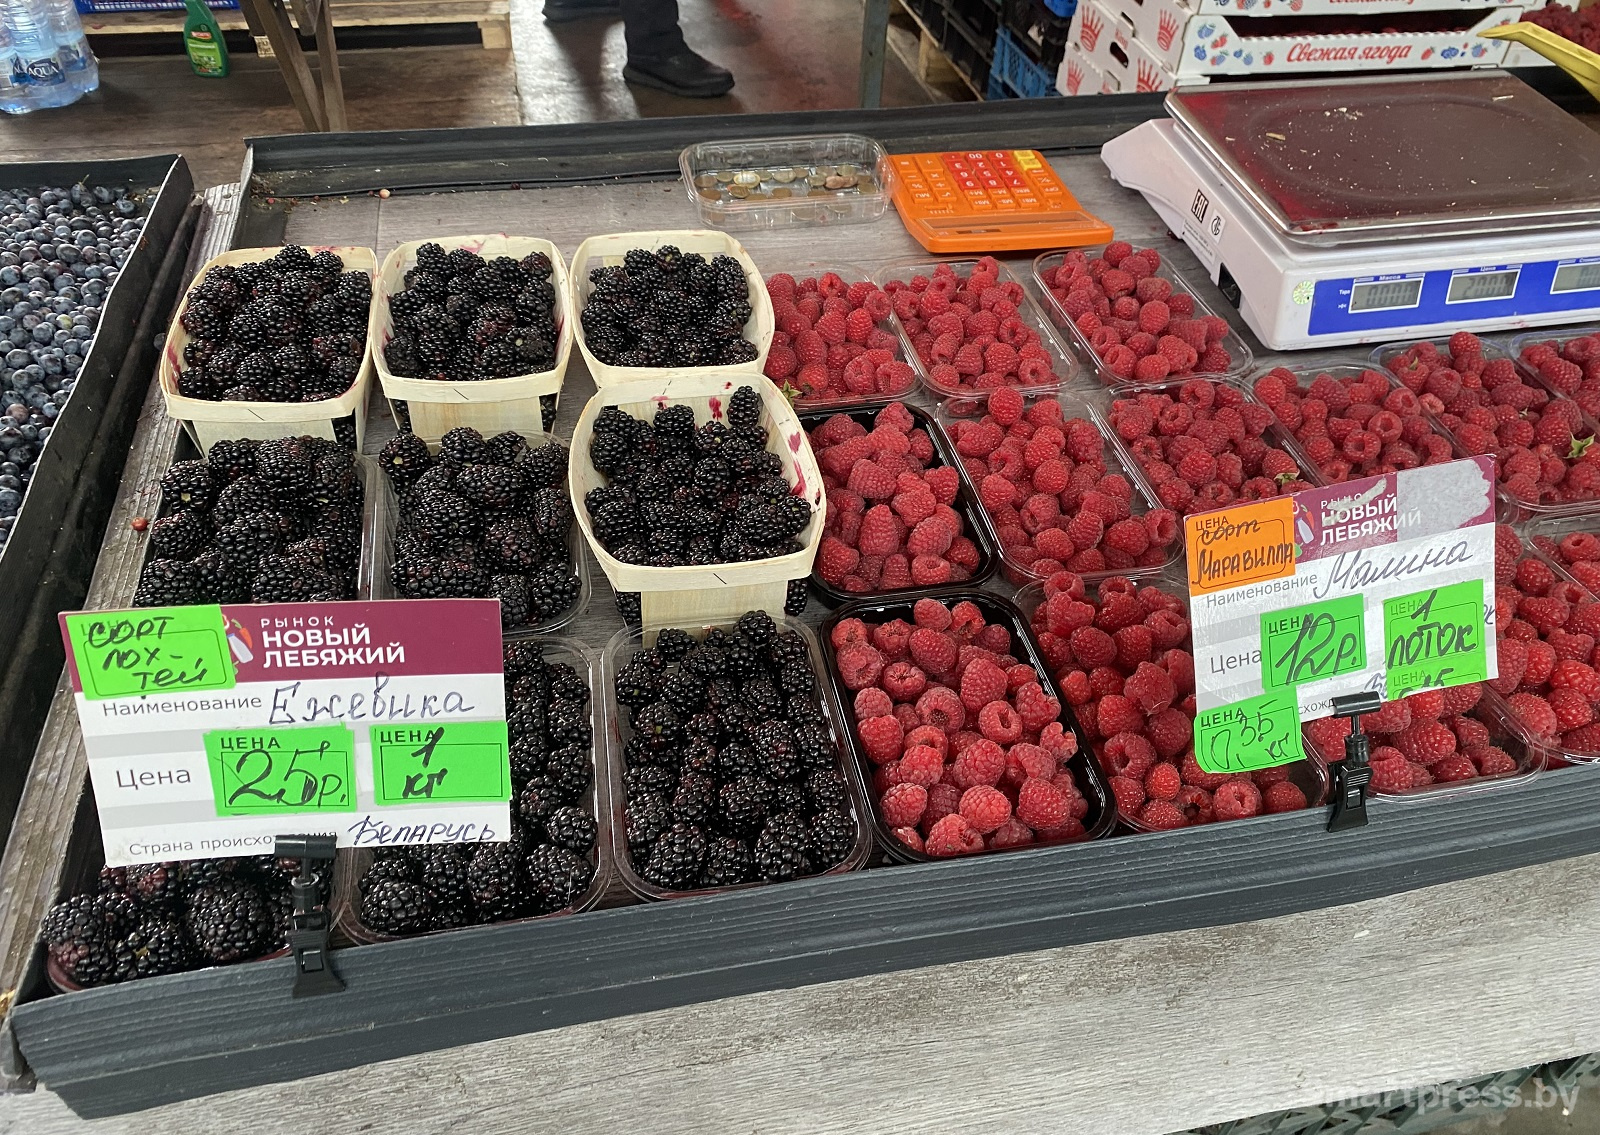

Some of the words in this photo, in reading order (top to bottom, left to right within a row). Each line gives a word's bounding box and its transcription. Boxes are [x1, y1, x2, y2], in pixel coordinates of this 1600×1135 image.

[1286, 43, 1358, 62] Свежая
[1358, 44, 1413, 65] ягода
[28, 65, 59, 78] AQUA
[1195, 516, 1229, 531] ЦЕНА
[1320, 506, 1422, 546] ЛЕБЯЖИЙ
[1206, 574, 1318, 608] Наименование
[1313, 540, 1474, 599] Малина
[1410, 589, 1437, 621] 1
[261, 616, 334, 628] РЫНОК
[1268, 615, 1302, 634] ЦЕН
[262, 623, 370, 648] НОВЫЙ
[263, 641, 405, 669] ЛЕБЯЖИЙ
[1210, 649, 1262, 674] Цена
[1393, 669, 1426, 687] ЦЕНА
[102, 697, 262, 717] Наименование
[268, 672, 475, 725] Ежевика
[1201, 707, 1244, 728] ЦЕНА
[220, 736, 281, 751] ЦЕНА
[411, 727, 445, 768] 1
[115, 769, 192, 792] Цена
[402, 768, 448, 799] кг
[129, 838, 193, 857] Страна
